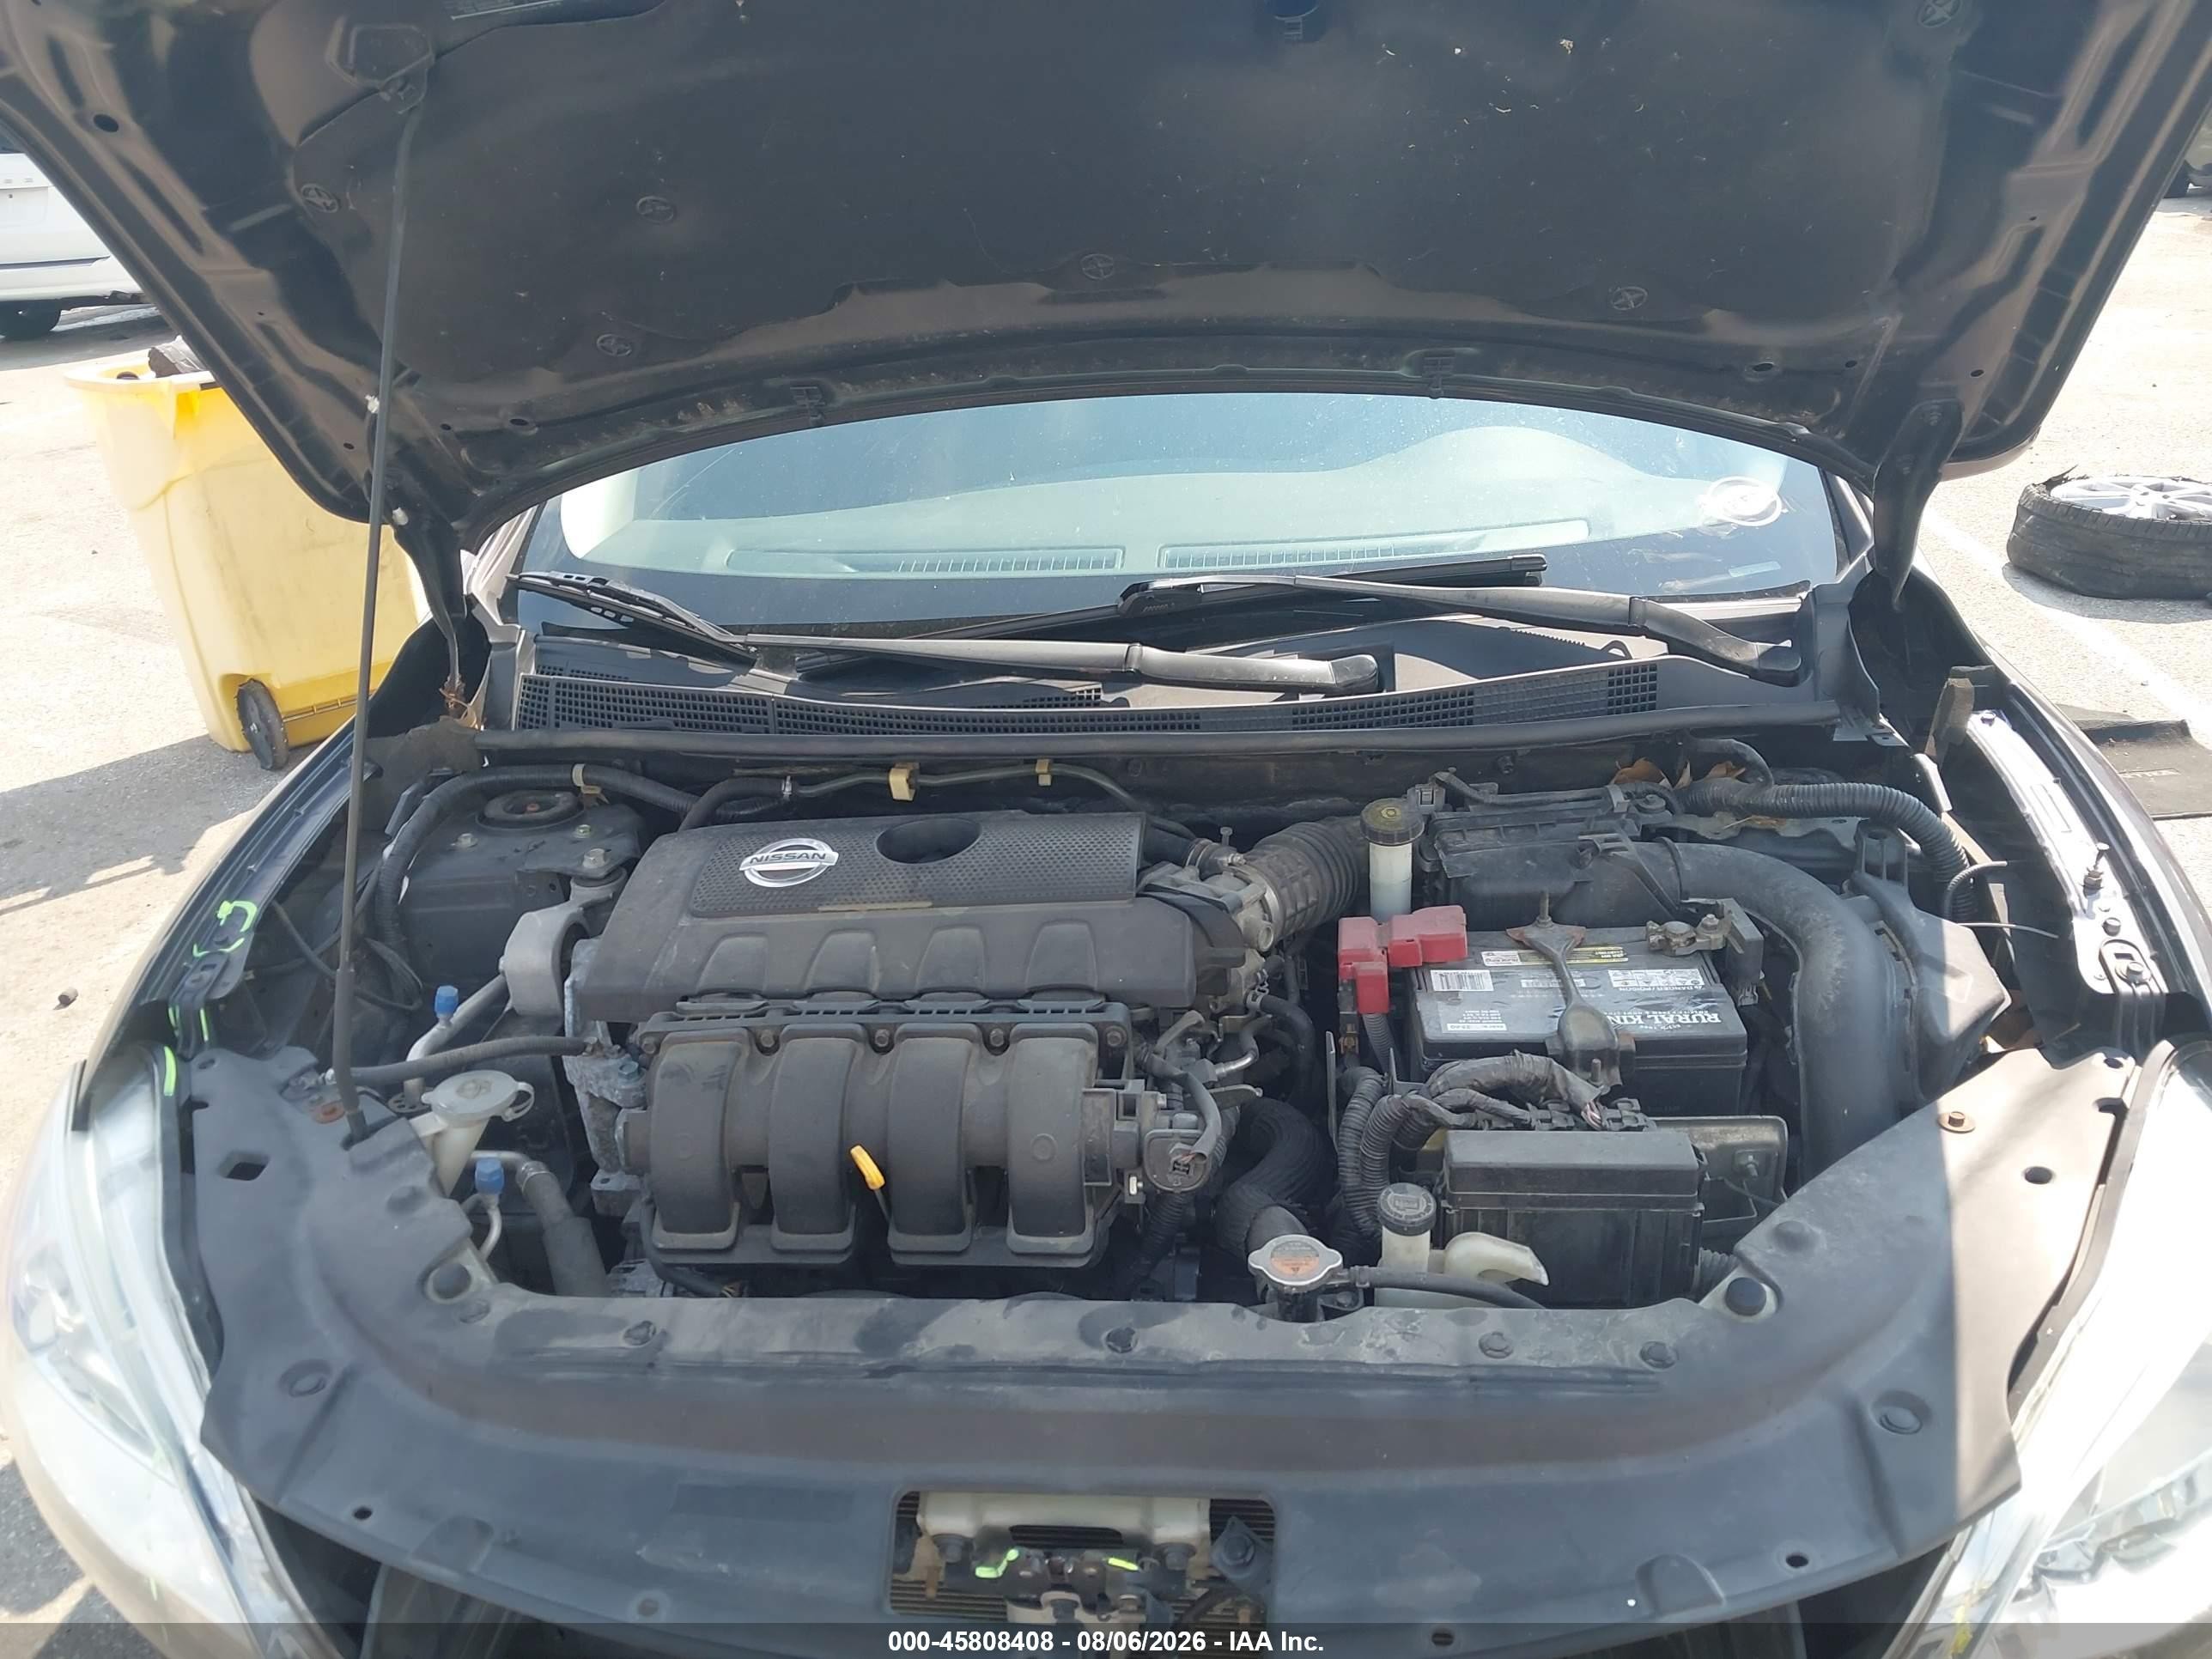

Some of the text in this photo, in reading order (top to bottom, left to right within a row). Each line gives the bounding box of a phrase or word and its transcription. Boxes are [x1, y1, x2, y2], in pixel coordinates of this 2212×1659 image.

[750, 853, 826, 864] NISSAN
[1607, 1012, 1722, 1024] RURAL KIN
